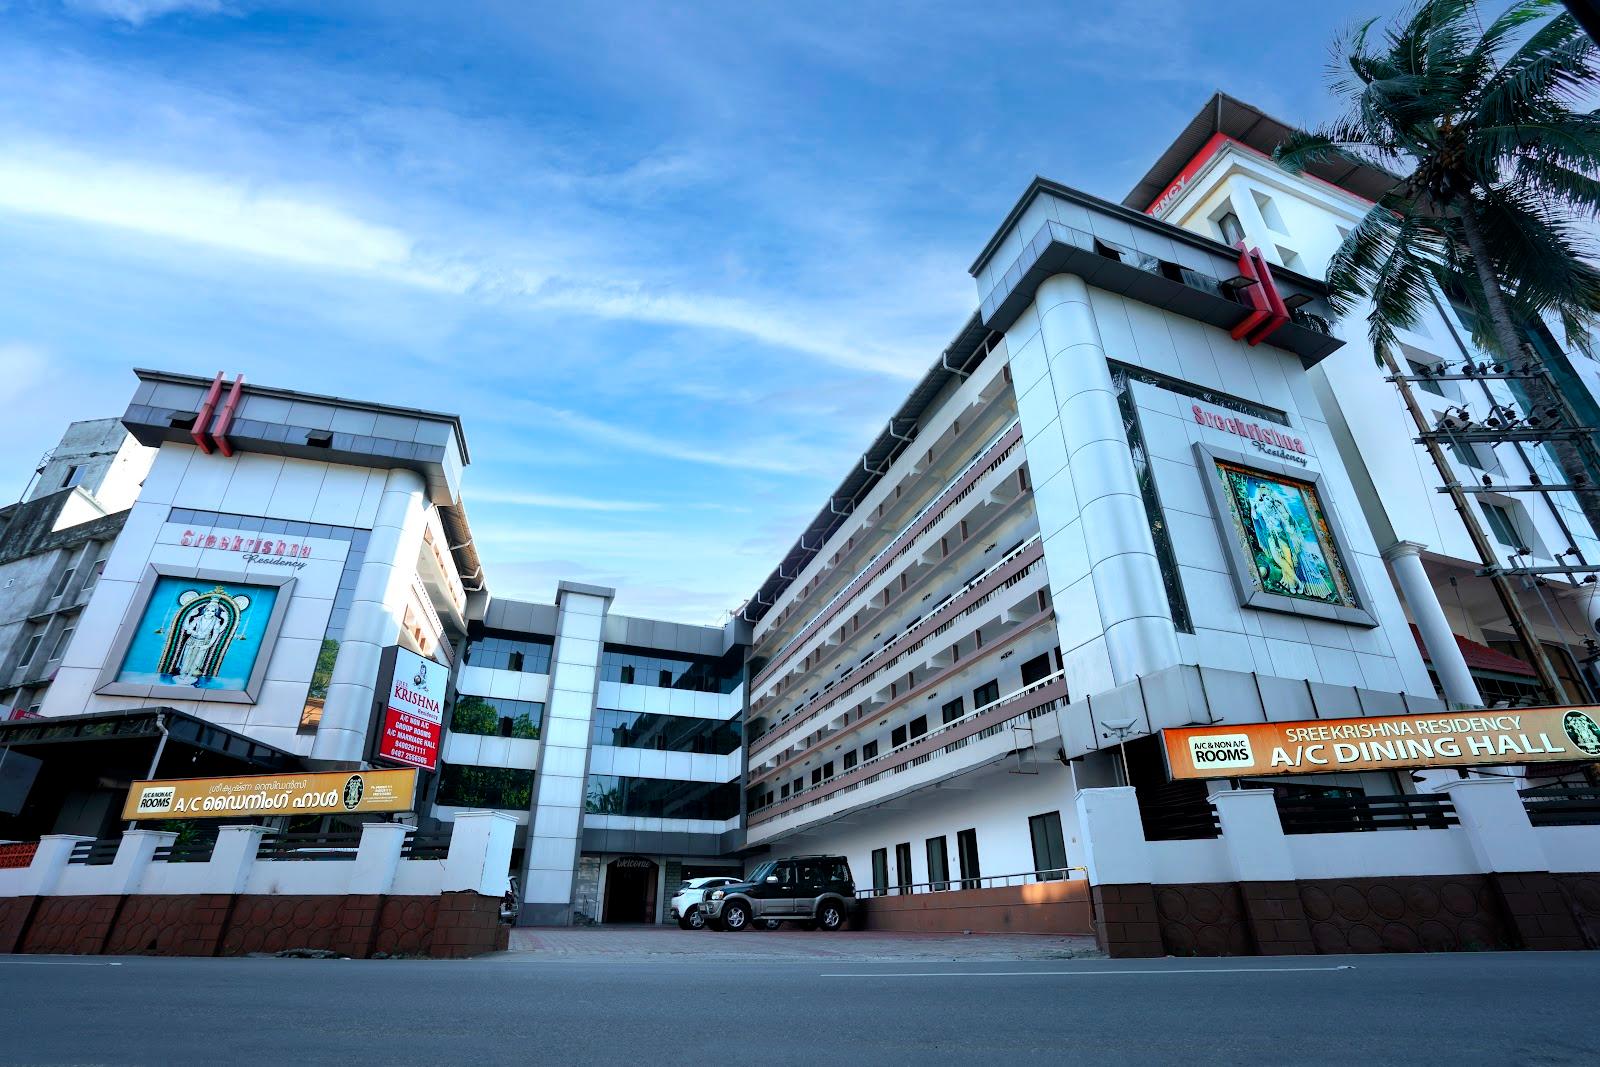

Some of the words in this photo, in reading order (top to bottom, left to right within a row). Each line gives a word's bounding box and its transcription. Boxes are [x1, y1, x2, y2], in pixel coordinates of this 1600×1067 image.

[1148, 174, 1188, 219] ENCY
[1191, 404, 1306, 455] Sreekrishna
[1251, 440, 1308, 467] Residency
[180, 529, 312, 559] Sreekrishna
[242, 553, 308, 571] Residency
[394, 685, 440, 714] KRISHNA
[395, 721, 413, 732] GROUP
[413, 727, 432, 739] ROOMS
[400, 713, 410, 723] A/C
[420, 720, 430, 730] A/C
[1416, 715, 1521, 735] RESIDENCY
[387, 728, 397, 737] A/C
[397, 731, 424, 746] MARRIAGE
[423, 740, 436, 749] HALL
[1194, 742, 1207, 750] A/C
[1214, 741, 1232, 749] NON
[1233, 740, 1246, 748] A/C
[1195, 748, 1249, 763] ROOMS
[1270, 743, 1328, 768] A/C
[1332, 736, 1462, 764] DINING
[1466, 732, 1566, 756] HALL
[140, 797, 171, 808] ROOMS
[174, 796, 202, 813] A/C
